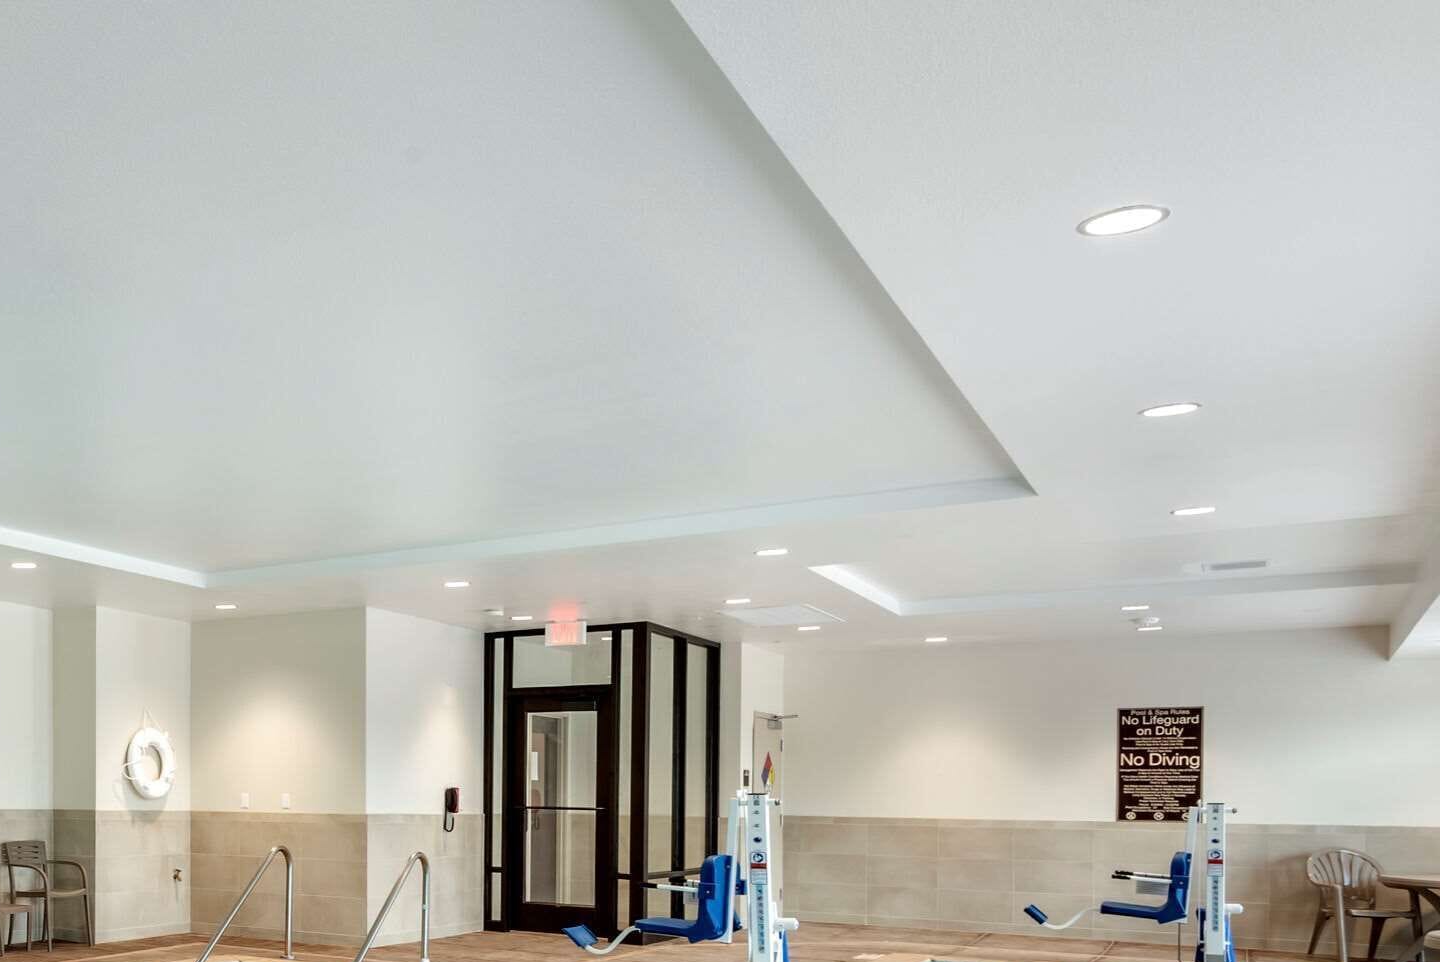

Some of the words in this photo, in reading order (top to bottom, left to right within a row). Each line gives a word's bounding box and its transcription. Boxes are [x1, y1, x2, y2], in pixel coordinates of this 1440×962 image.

[1121, 715, 1139, 725] No
[1142, 714, 1200, 726] Lifeguard
[1136, 728, 1152, 736] on
[1155, 726, 1184, 737] Duty
[1120, 753, 1145, 766] No
[1149, 753, 1201, 769] Diving
